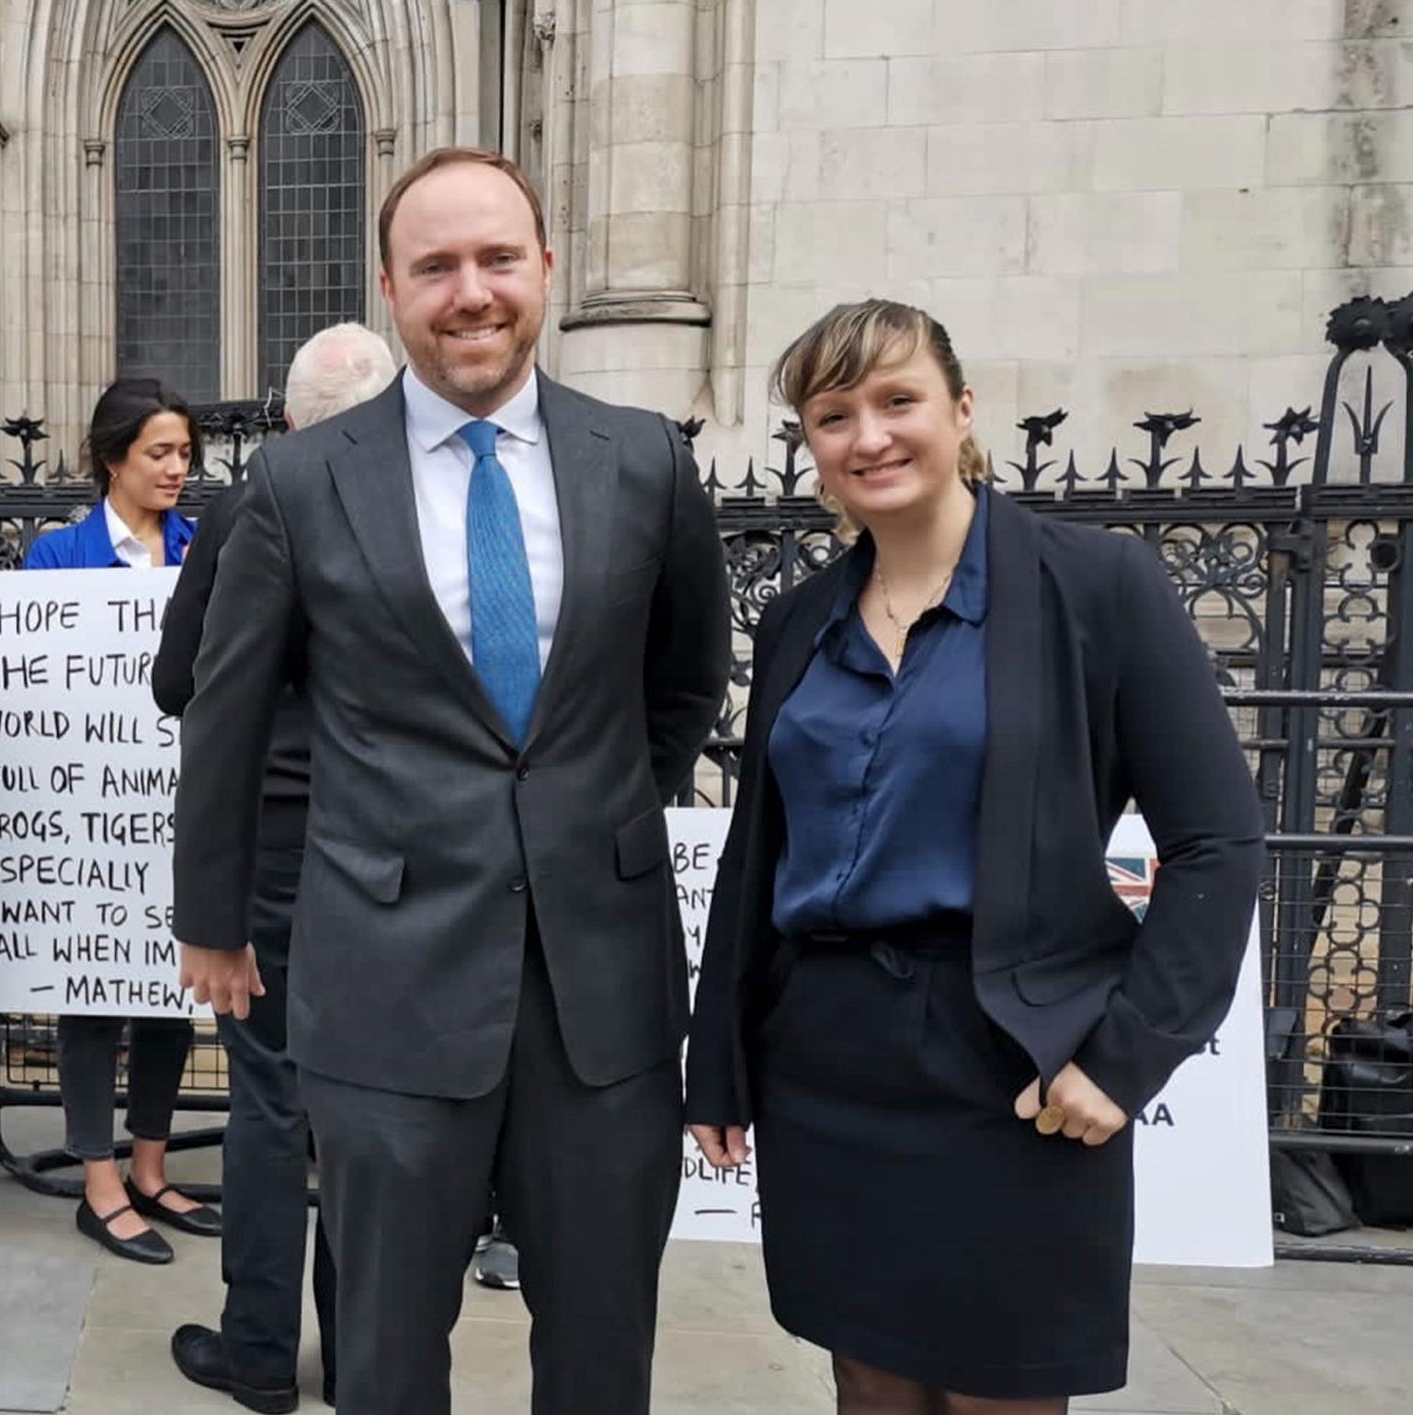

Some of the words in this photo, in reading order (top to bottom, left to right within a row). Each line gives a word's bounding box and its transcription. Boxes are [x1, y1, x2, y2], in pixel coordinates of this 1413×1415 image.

[65, 652, 154, 693] FUTUR
[84, 710, 143, 745] WILL
[155, 712, 183, 750] S
[50, 762, 85, 795] OF
[673, 841, 711, 875] BE
[0, 898, 76, 925] WANT
[95, 902, 128, 927] TO
[52, 935, 131, 964] WHEN
[144, 939, 177, 967] IM
[63, 975, 195, 1016] MATHEW,
